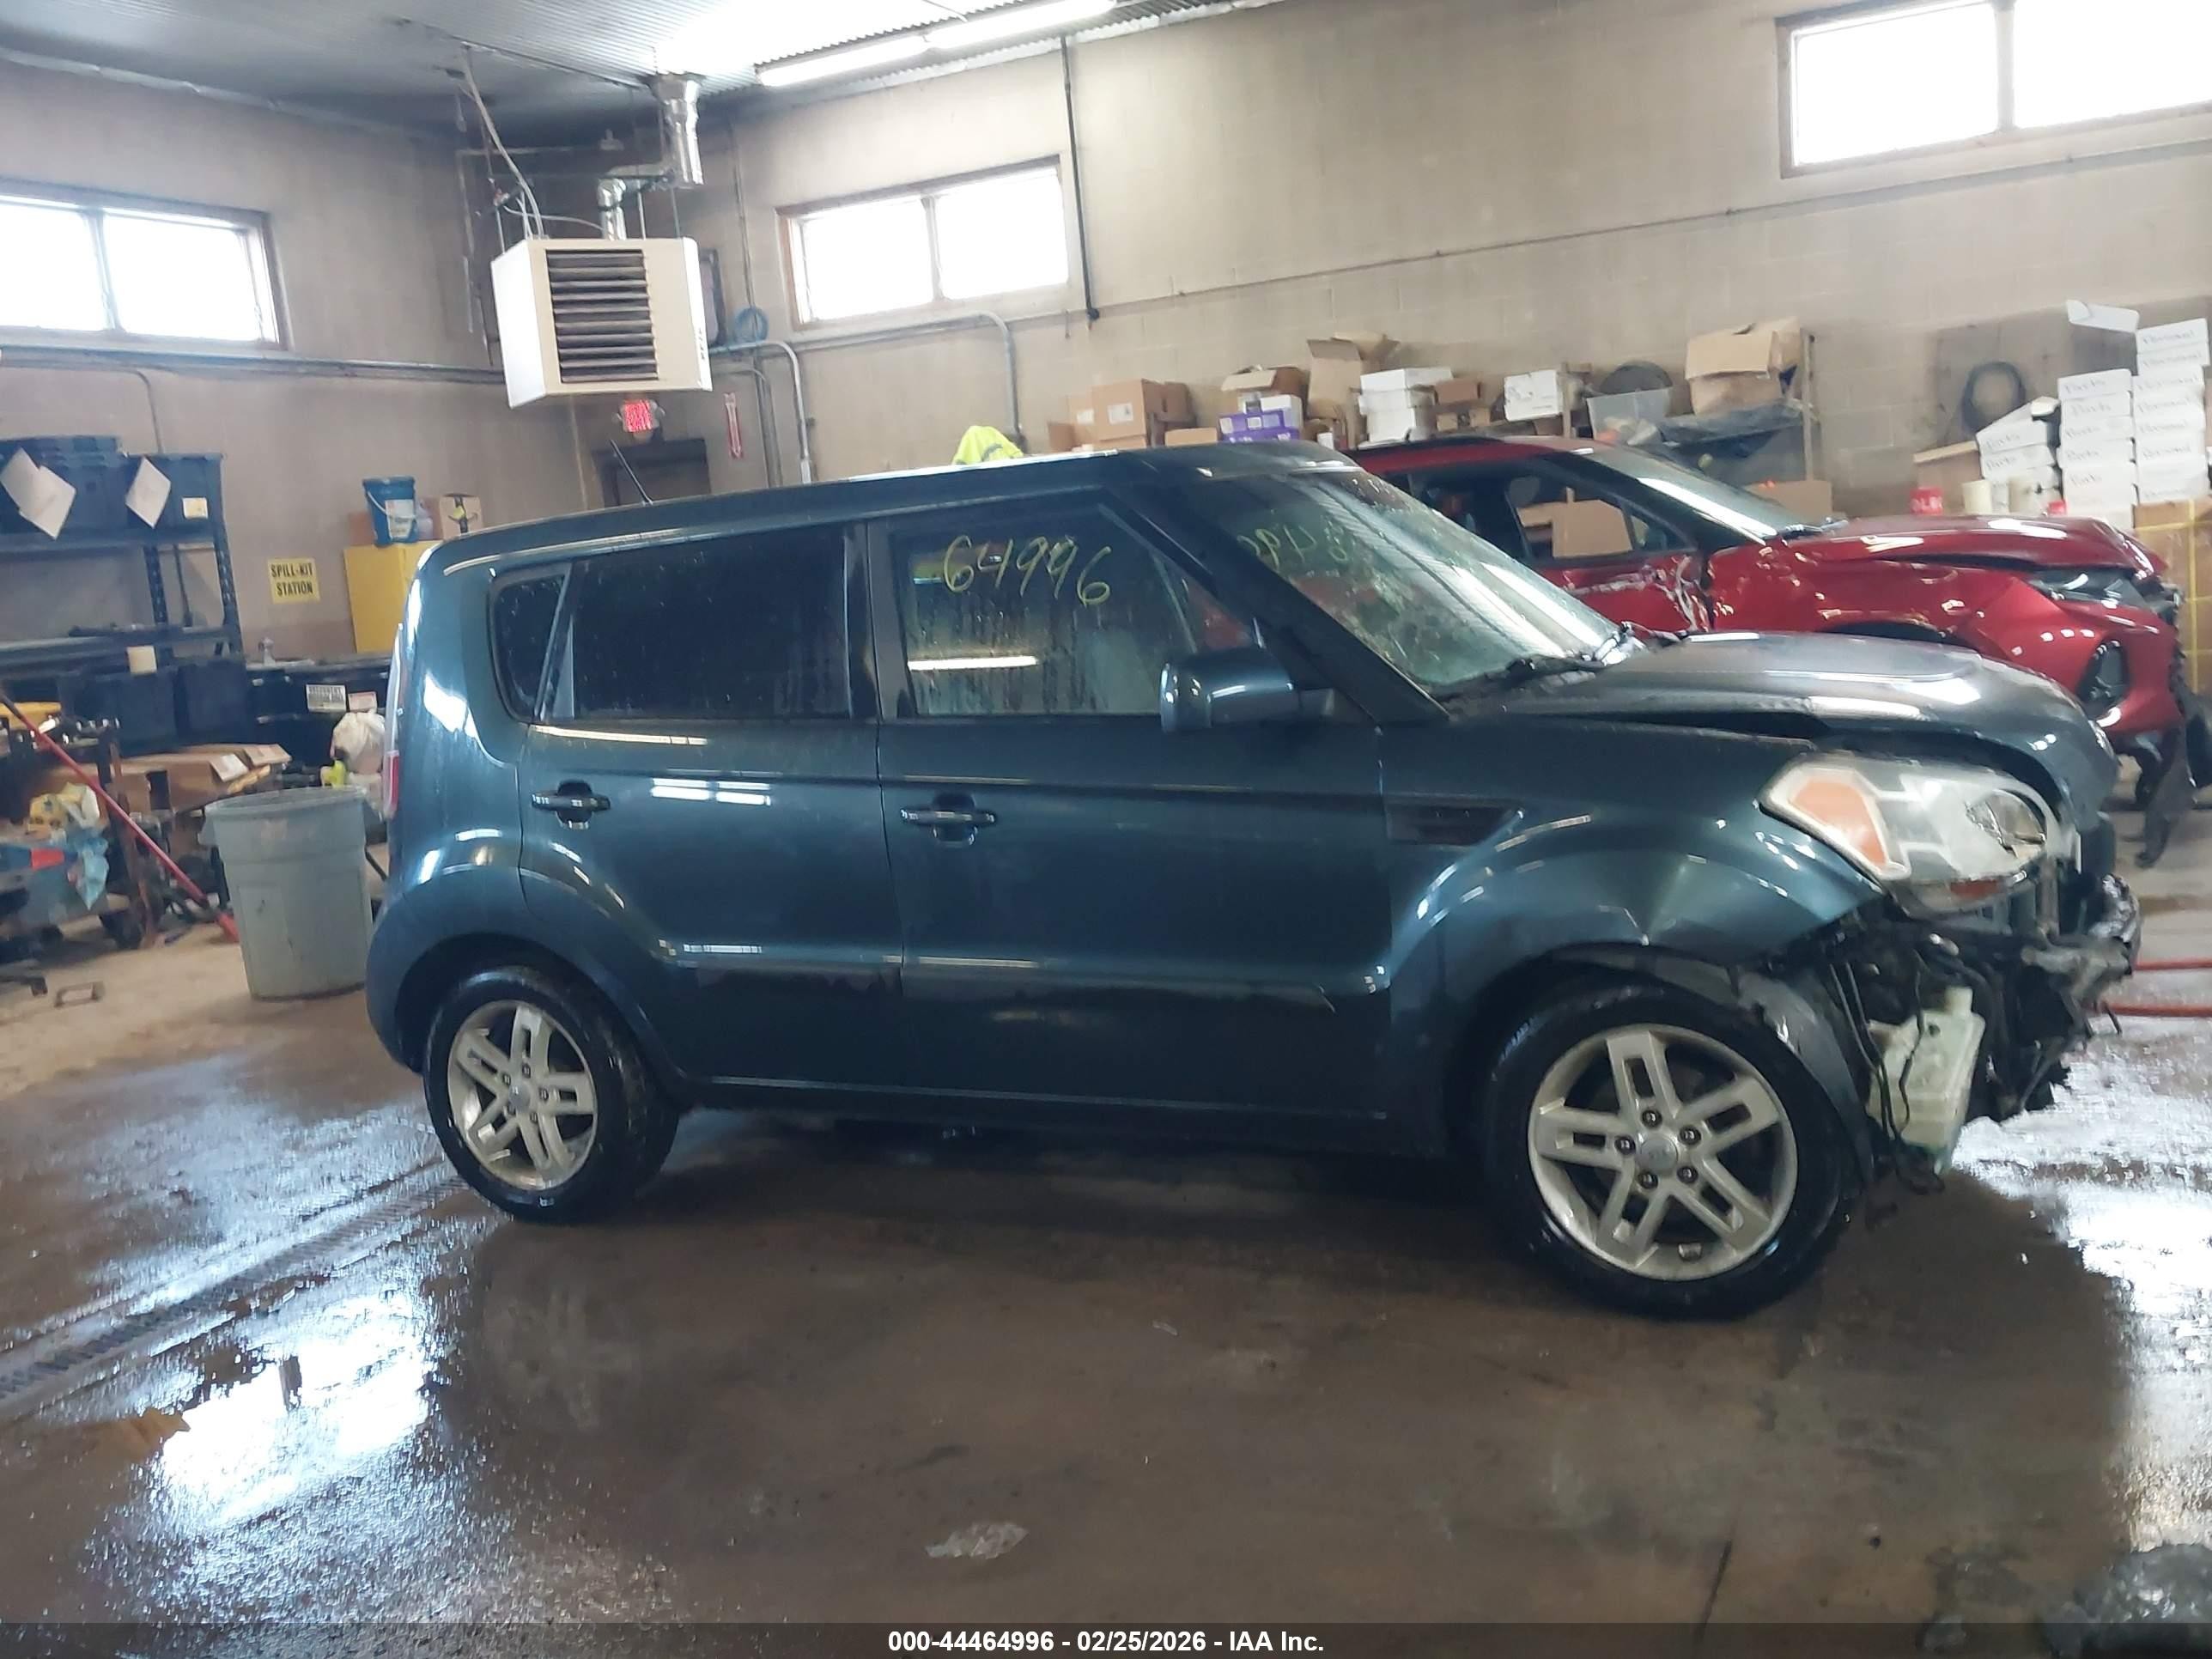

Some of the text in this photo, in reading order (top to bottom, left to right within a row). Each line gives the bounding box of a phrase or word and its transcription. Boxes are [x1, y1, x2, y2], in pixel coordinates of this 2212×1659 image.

[270, 562, 313, 578] SPILL-KIT
[945, 535, 1112, 608] 64996
[276, 580, 313, 597] STATION
